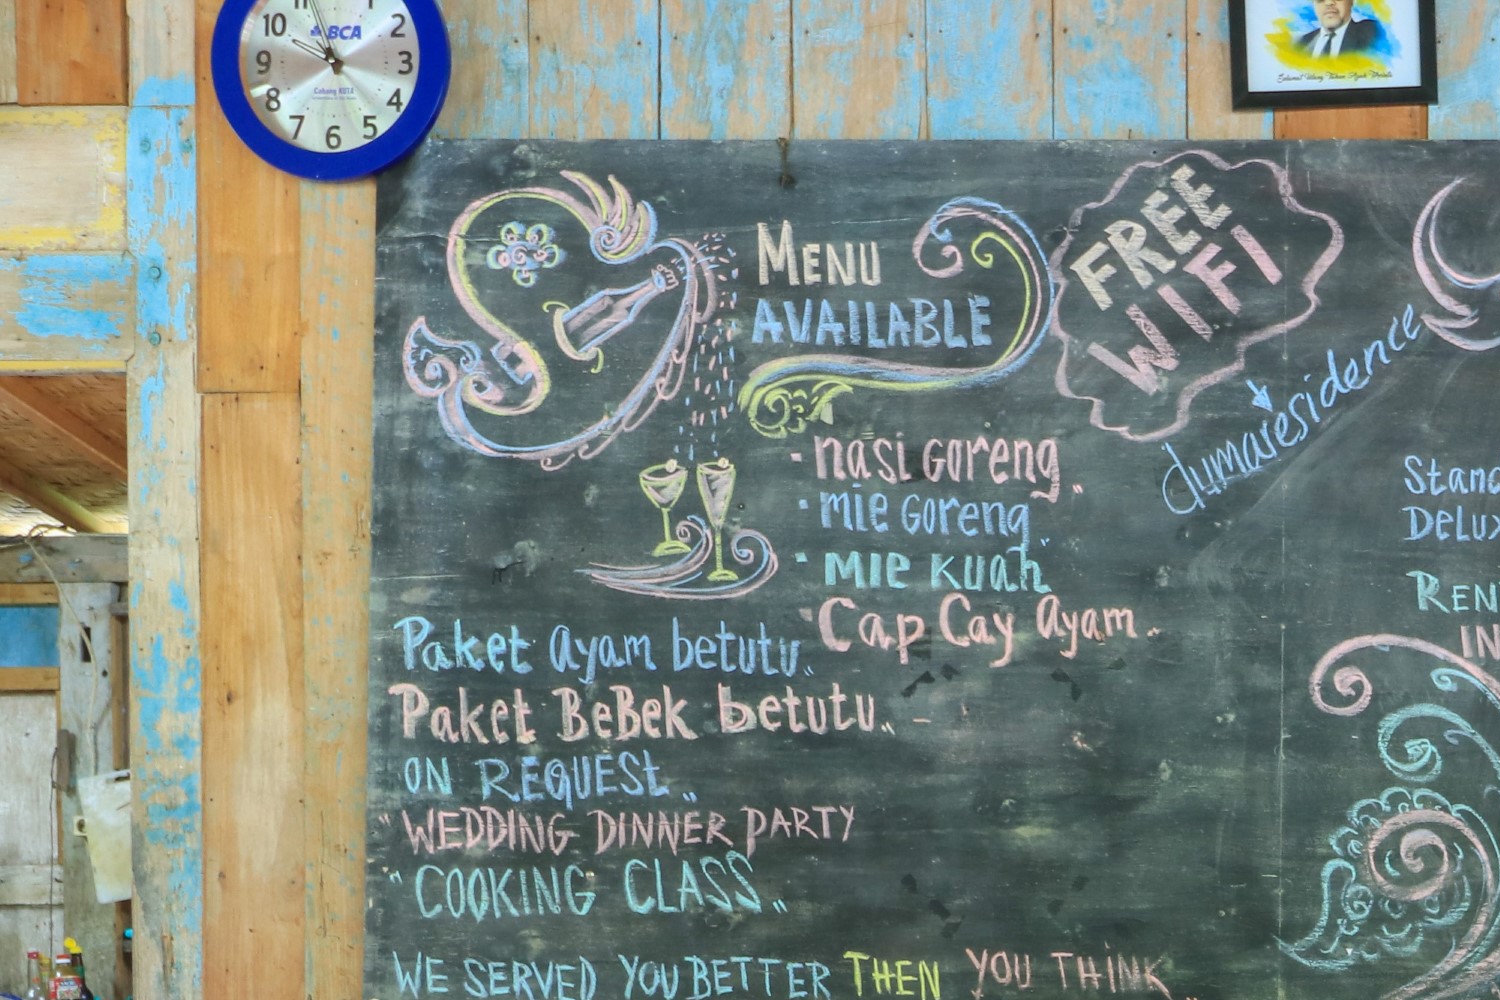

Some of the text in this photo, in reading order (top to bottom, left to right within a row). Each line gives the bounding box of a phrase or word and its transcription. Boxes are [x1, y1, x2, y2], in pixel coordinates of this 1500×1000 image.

[263, 13, 287, 37] 10
[327, 25, 362, 40] BCA
[390, 13, 406, 38] 2
[256, 50, 272, 75] 9
[397, 51, 413, 75] 3
[265, 87, 281, 112] 8
[386, 88, 403, 112] 4
[289, 115, 305, 140] 7
[325, 125, 342, 150] 6
[362, 115, 378, 140] 5
[1070, 164, 1232, 312] FREE
[751, 292, 993, 349] AVAILABLE
[1087, 225, 1283, 395] WIFI
[818, 597, 926, 665] Cap
[939, 593, 1015, 668] Cay
[393, 615, 535, 672] Paket
[388, 683, 536, 744] Paket
[404, 756, 454, 796] ON
[586, 806, 735, 856] DINNER
[392, 951, 448, 1000] WE
